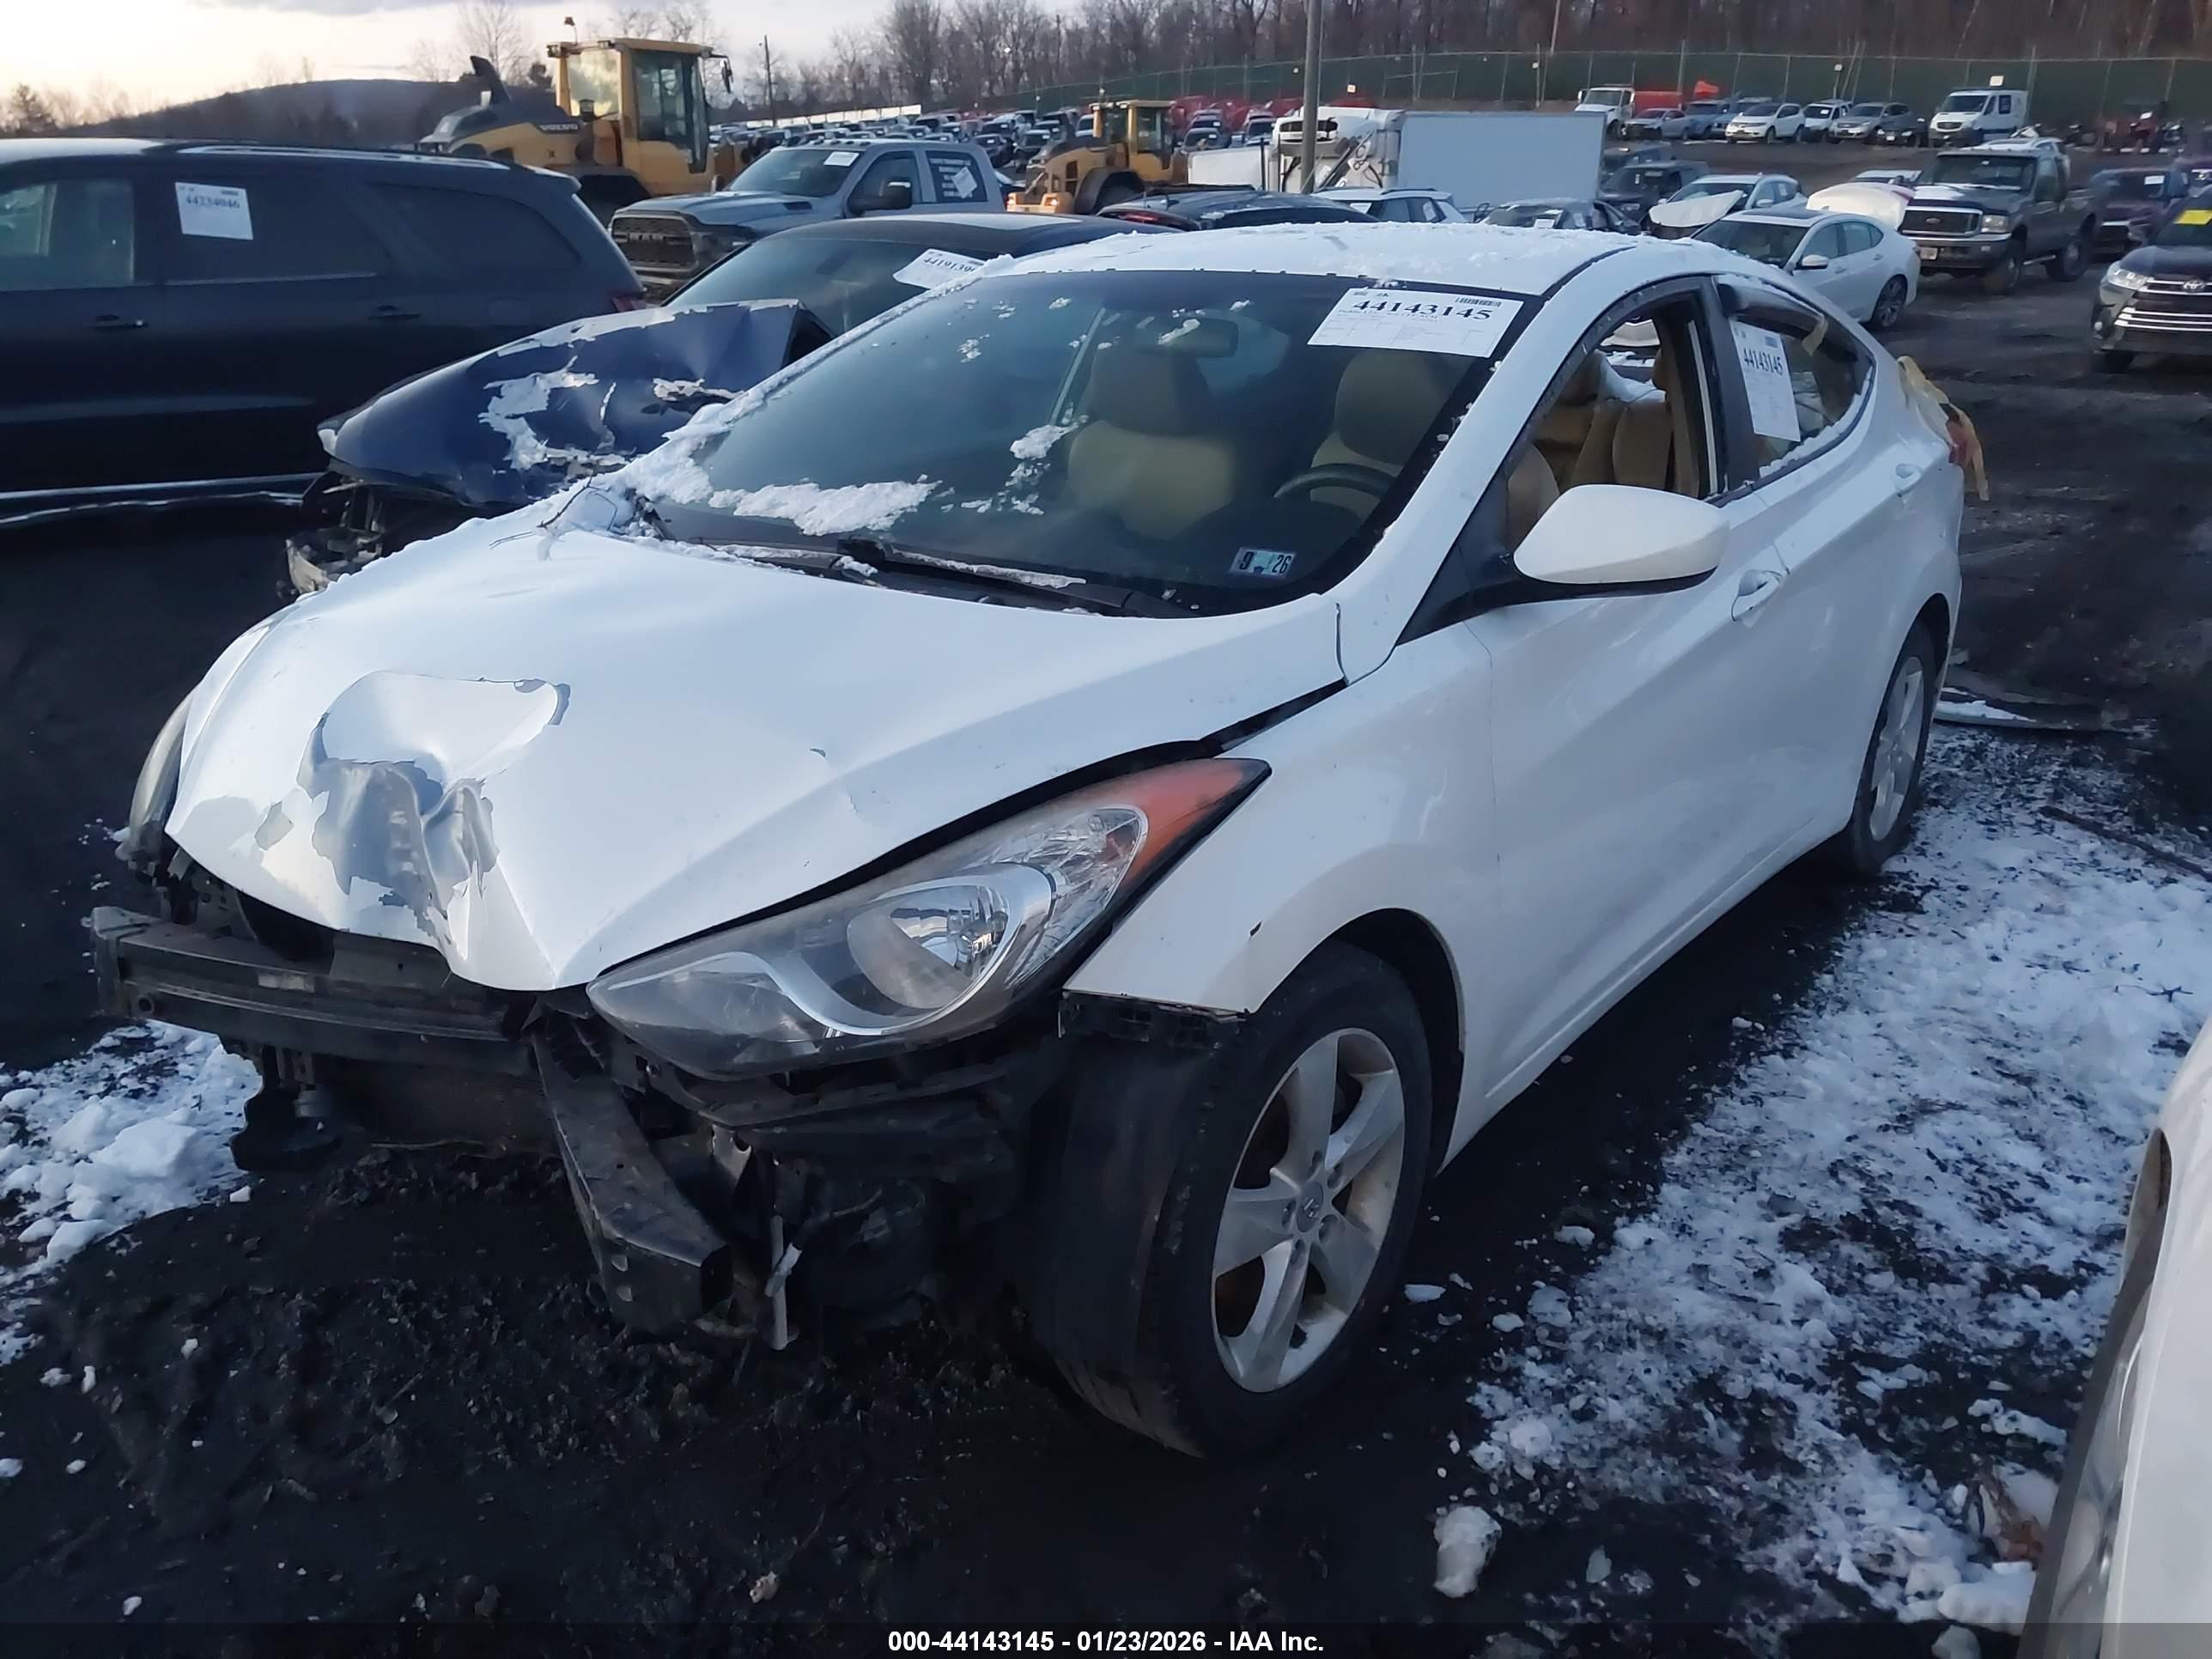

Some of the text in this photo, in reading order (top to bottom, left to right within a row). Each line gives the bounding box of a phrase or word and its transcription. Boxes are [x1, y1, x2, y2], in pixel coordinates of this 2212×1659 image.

[1352, 300, 1494, 320] 44143145
[1742, 347, 1784, 376] 44143145
[1271, 553, 1292, 574] 26
